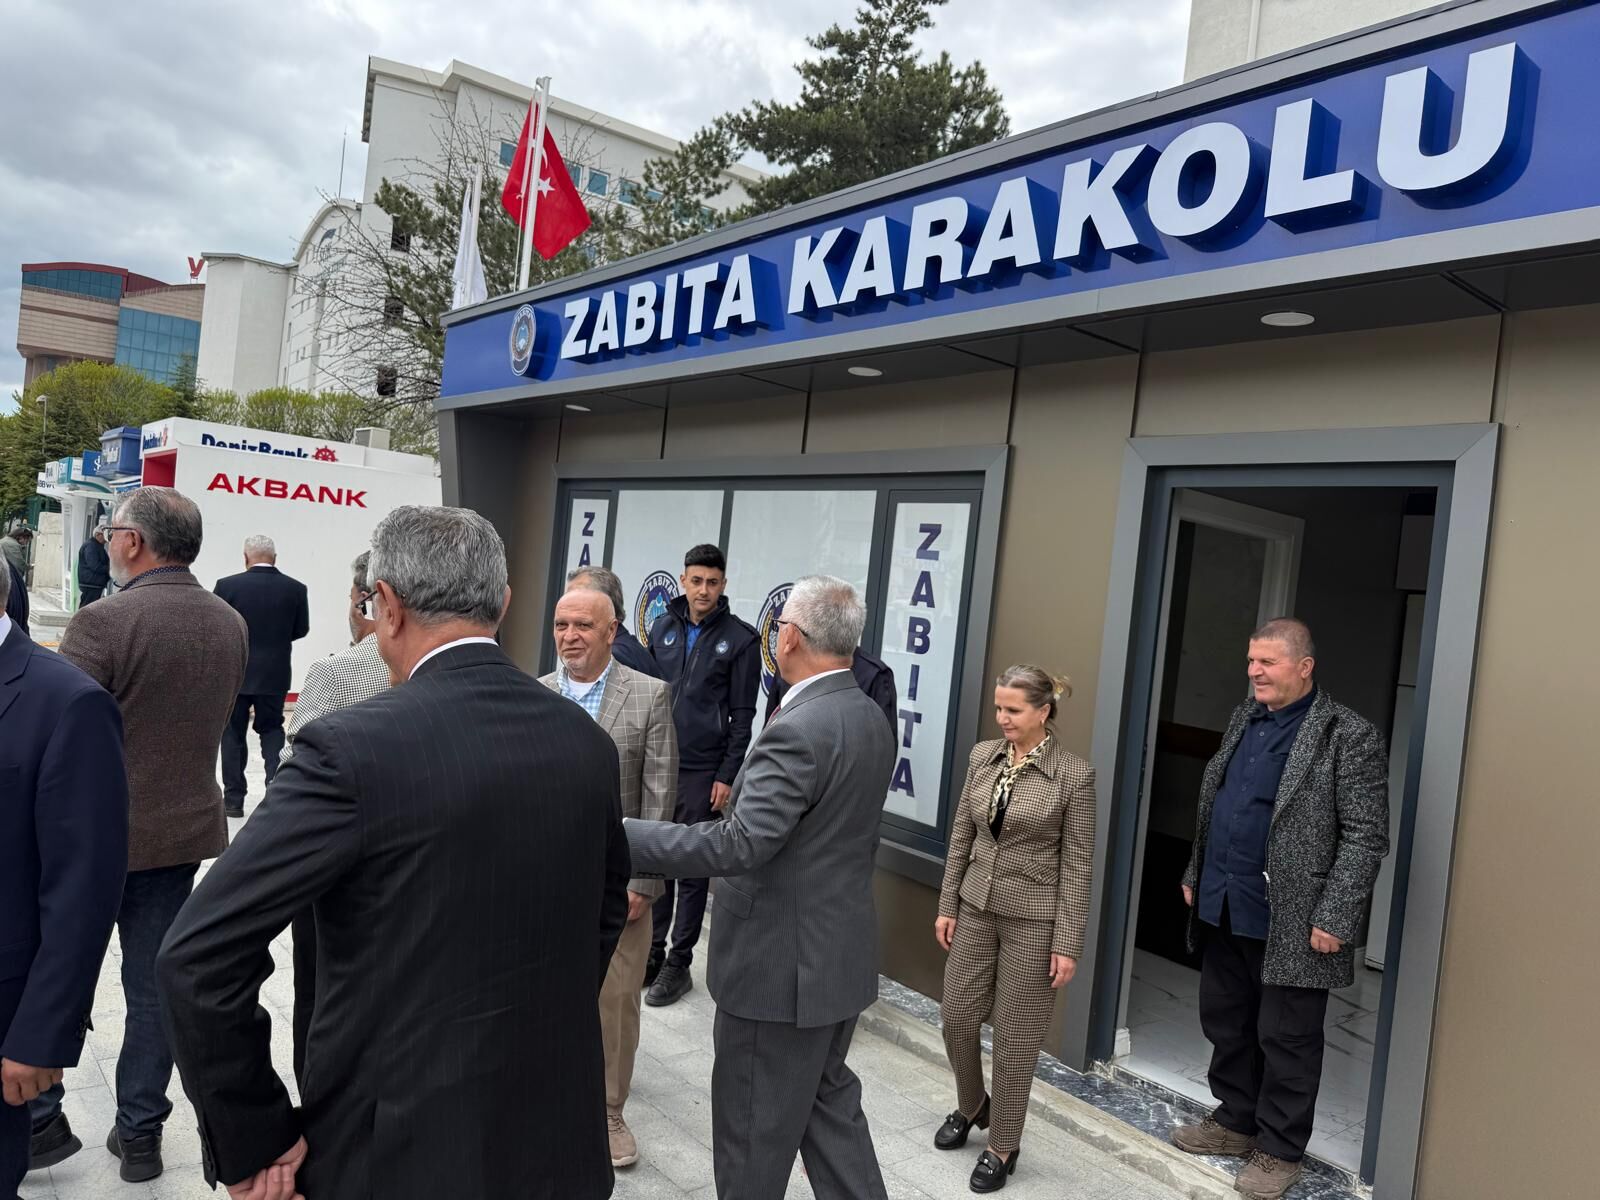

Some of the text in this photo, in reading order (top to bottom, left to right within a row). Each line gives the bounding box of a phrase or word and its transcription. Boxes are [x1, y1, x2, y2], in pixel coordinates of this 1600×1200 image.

[561, 43, 1516, 359] ZABITA KARAKOLU
[207, 473, 367, 508] AKBANK
[648, 576, 674, 594] ZABITA
[890, 523, 942, 798] ZABITA
